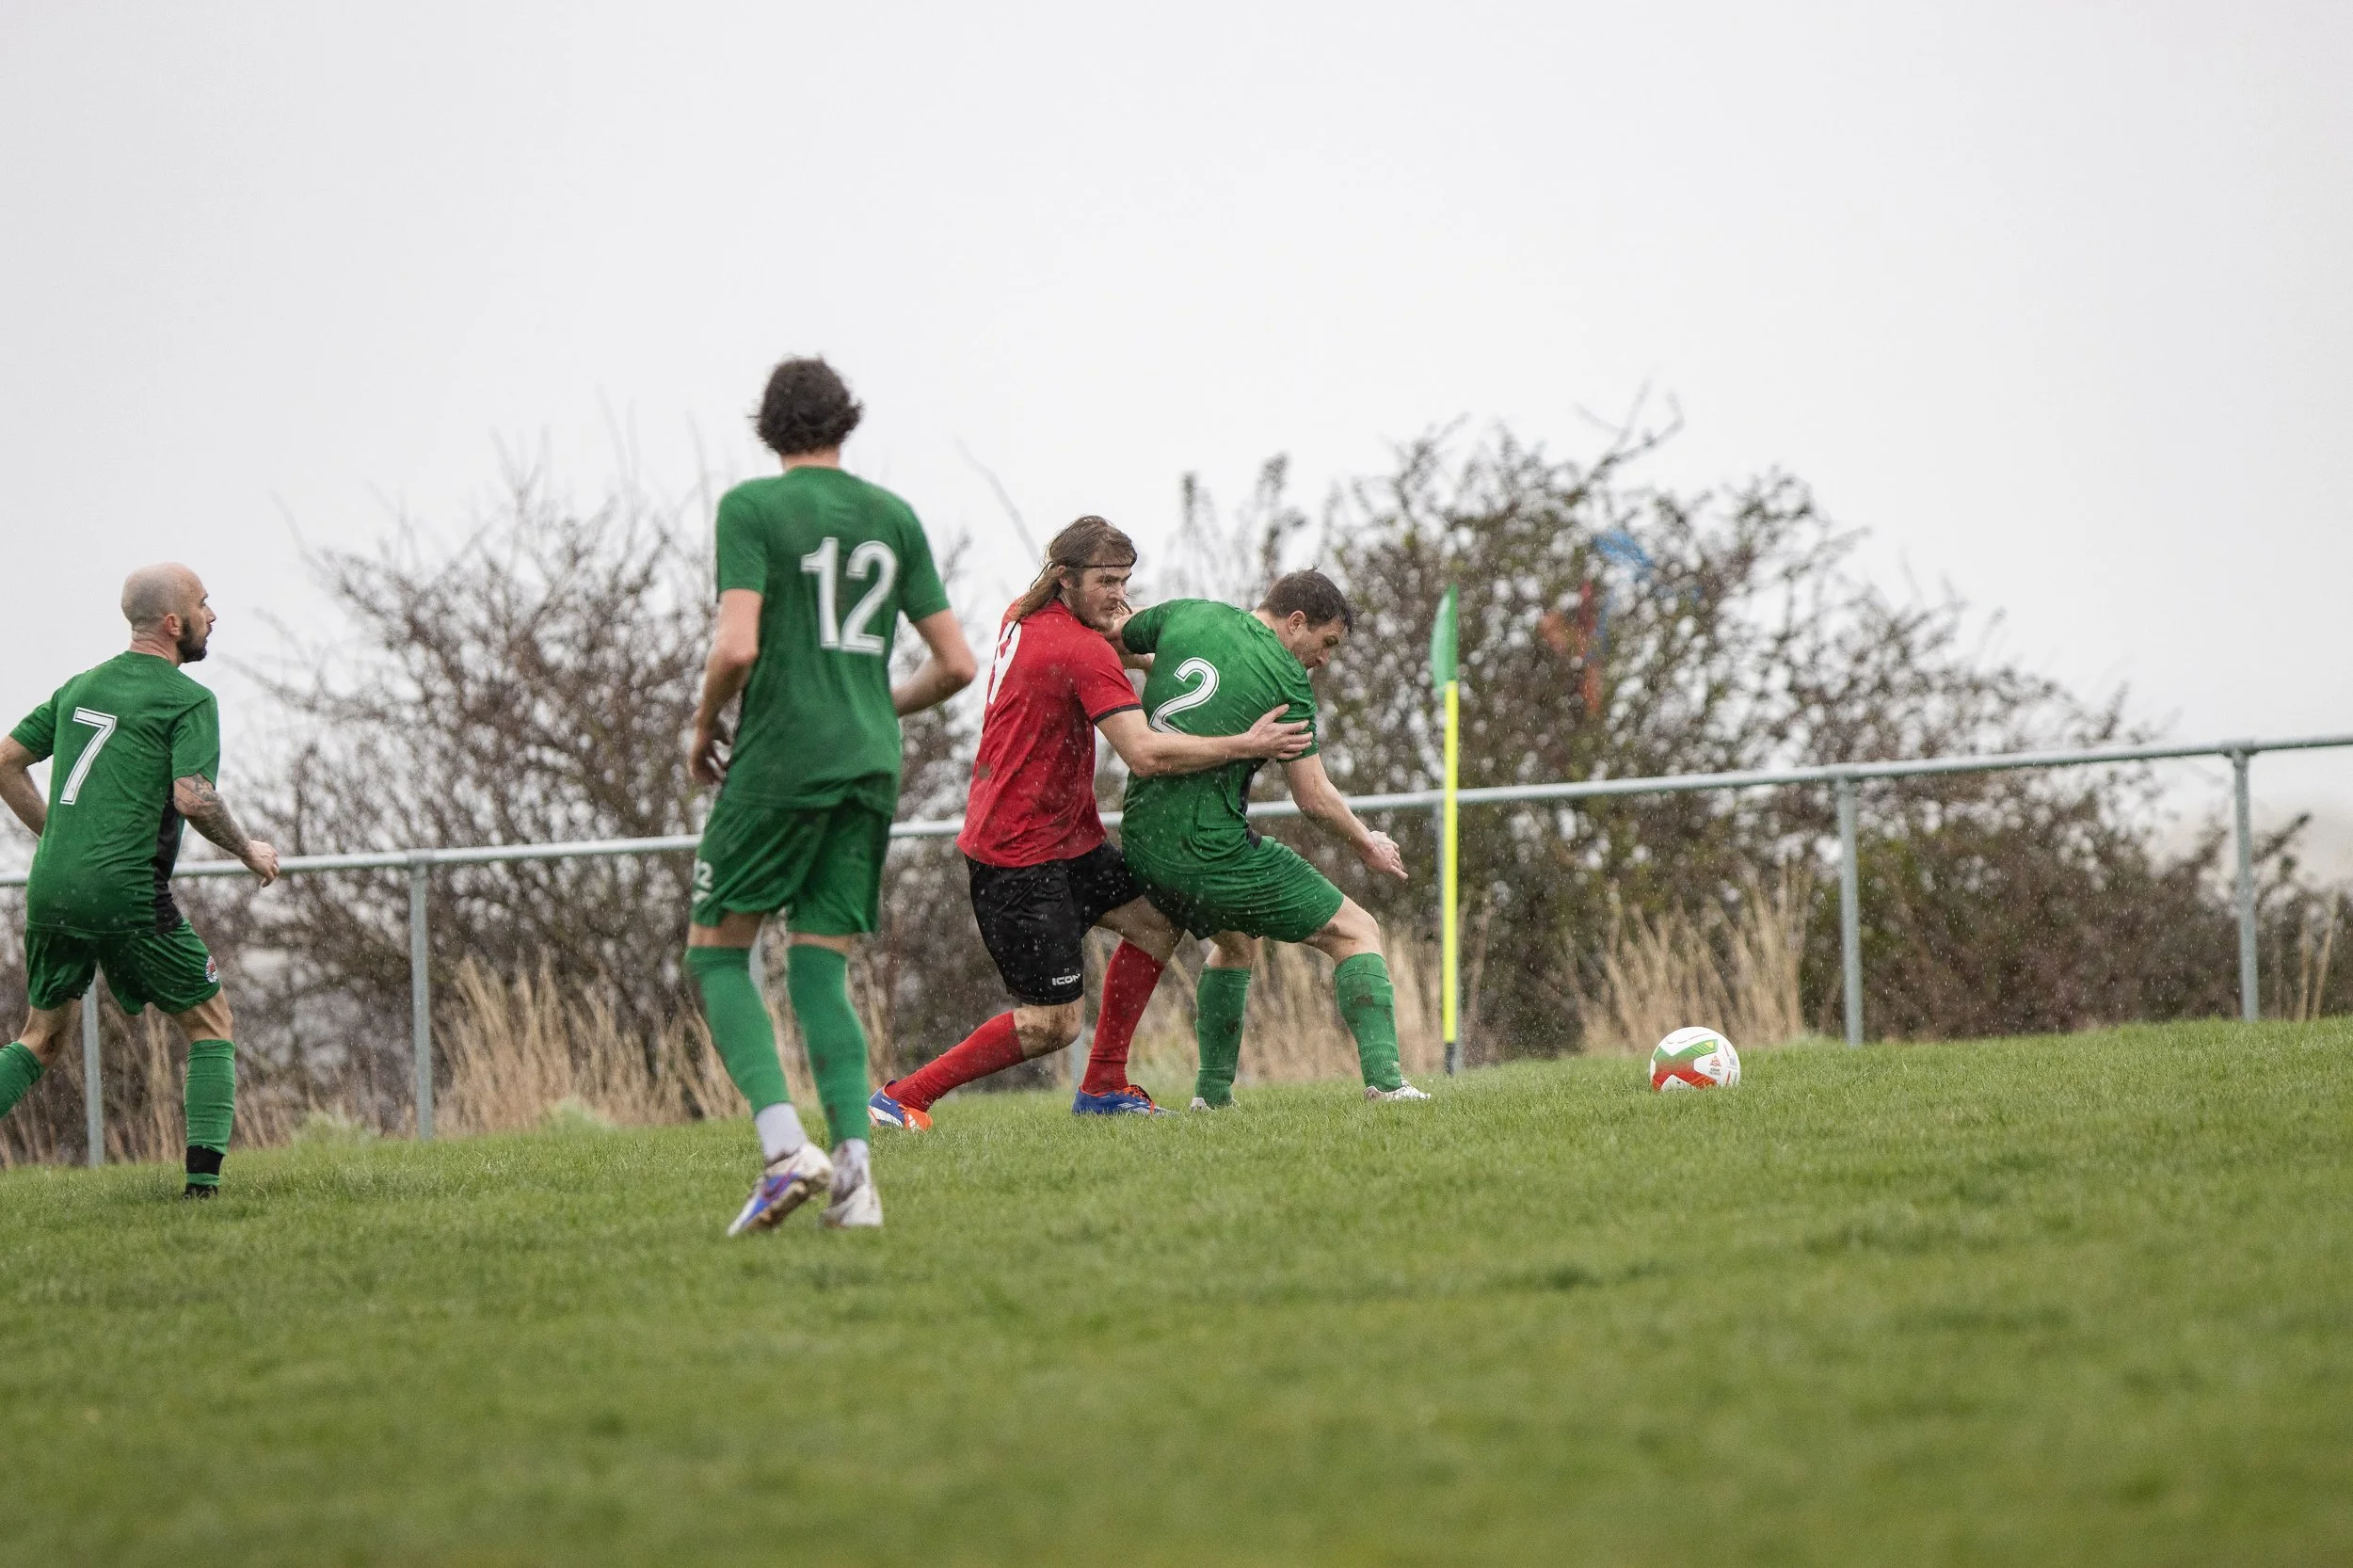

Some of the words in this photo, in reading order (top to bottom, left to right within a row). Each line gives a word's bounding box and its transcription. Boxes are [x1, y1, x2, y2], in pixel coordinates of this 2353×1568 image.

[801, 536, 897, 655] 12
[1148, 657, 1220, 734] 2
[59, 706, 118, 806] 7
